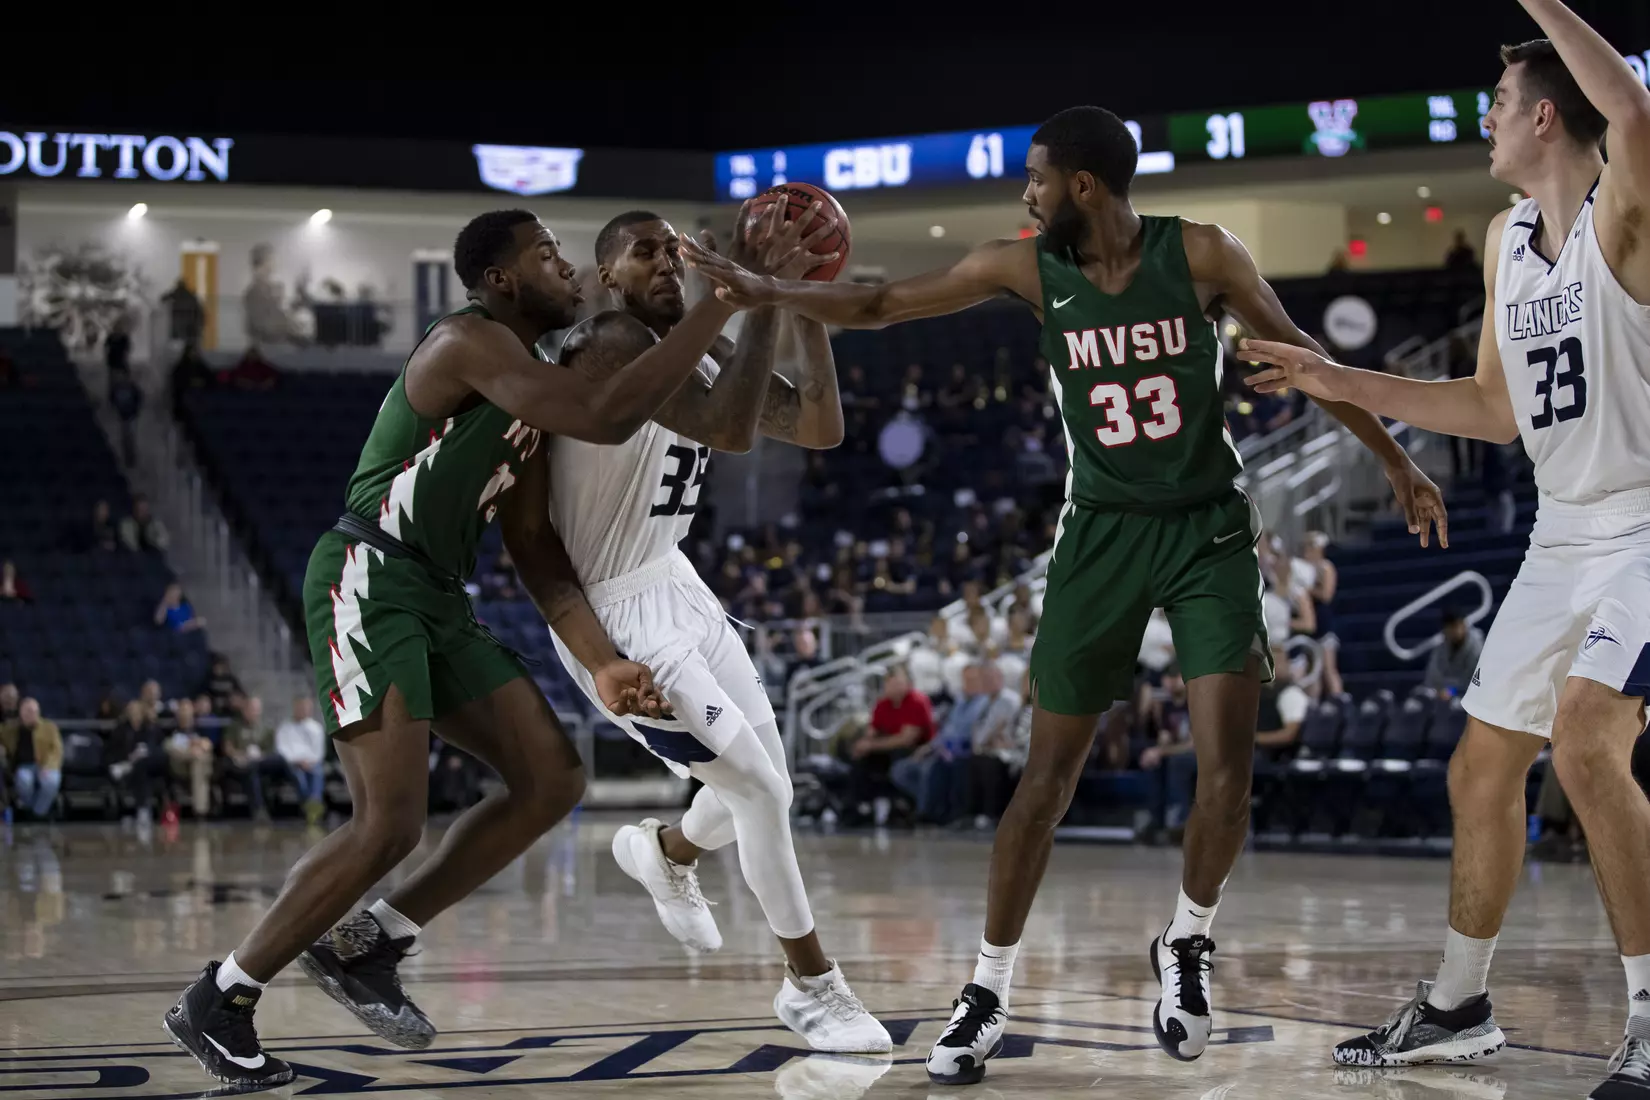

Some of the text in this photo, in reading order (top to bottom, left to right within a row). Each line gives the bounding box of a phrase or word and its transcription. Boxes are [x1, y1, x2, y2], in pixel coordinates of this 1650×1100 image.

[824, 144, 912, 191] CBU
[966, 132, 1004, 178] 61
[1206, 112, 1245, 159] 31
[1506, 281, 1583, 340] LANCRS
[1063, 316, 1187, 370] MVSU
[1088, 373, 1183, 448] 33
[1526, 336, 1587, 430] 33
